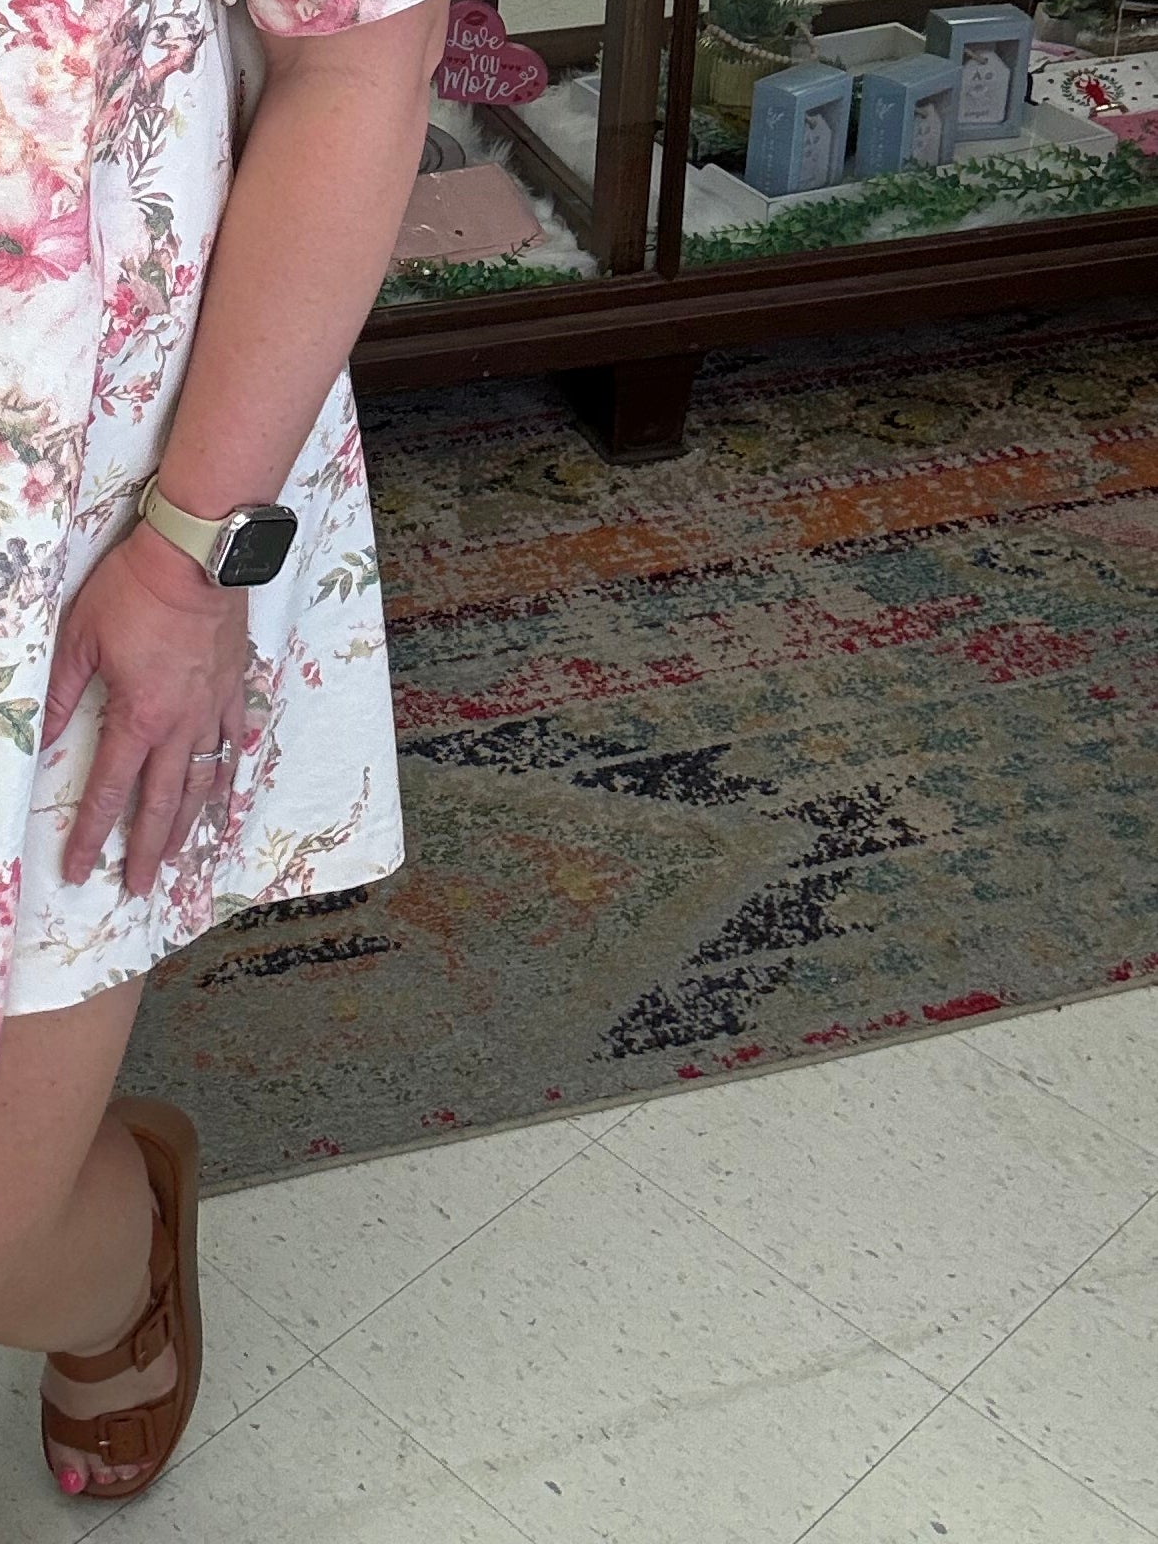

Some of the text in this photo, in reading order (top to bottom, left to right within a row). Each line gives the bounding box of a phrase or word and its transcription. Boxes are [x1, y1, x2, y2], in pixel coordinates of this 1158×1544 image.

[447, 18, 504, 51] Love
[469, 53, 501, 74] YOU
[443, 65, 538, 101] More
